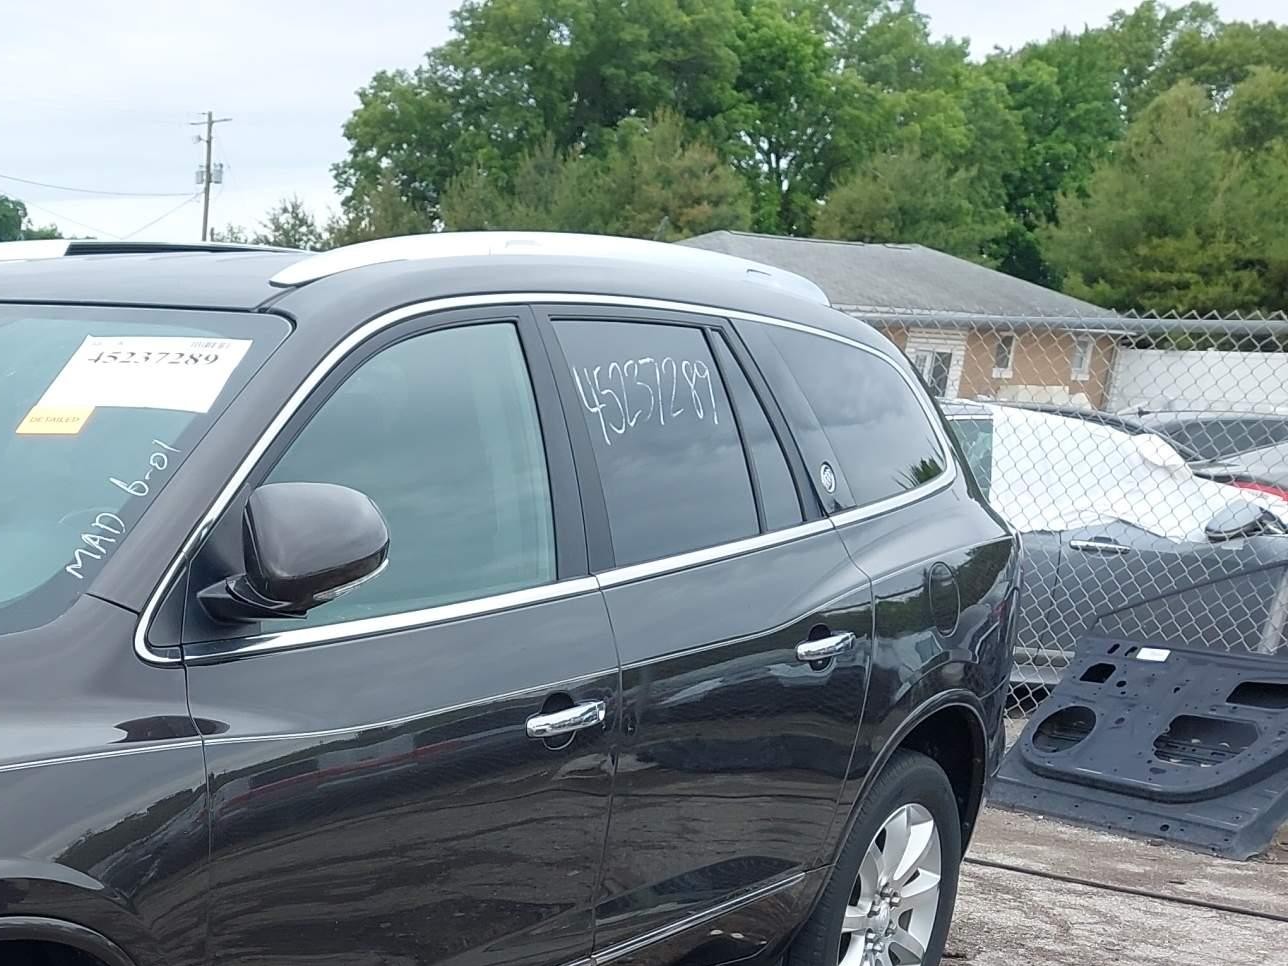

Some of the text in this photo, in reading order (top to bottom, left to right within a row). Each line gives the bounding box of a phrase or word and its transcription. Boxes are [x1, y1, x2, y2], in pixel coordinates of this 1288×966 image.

[87, 351, 220, 366] 45237289
[572, 356, 719, 446] 45237289
[65, 512, 126, 579] MAD
